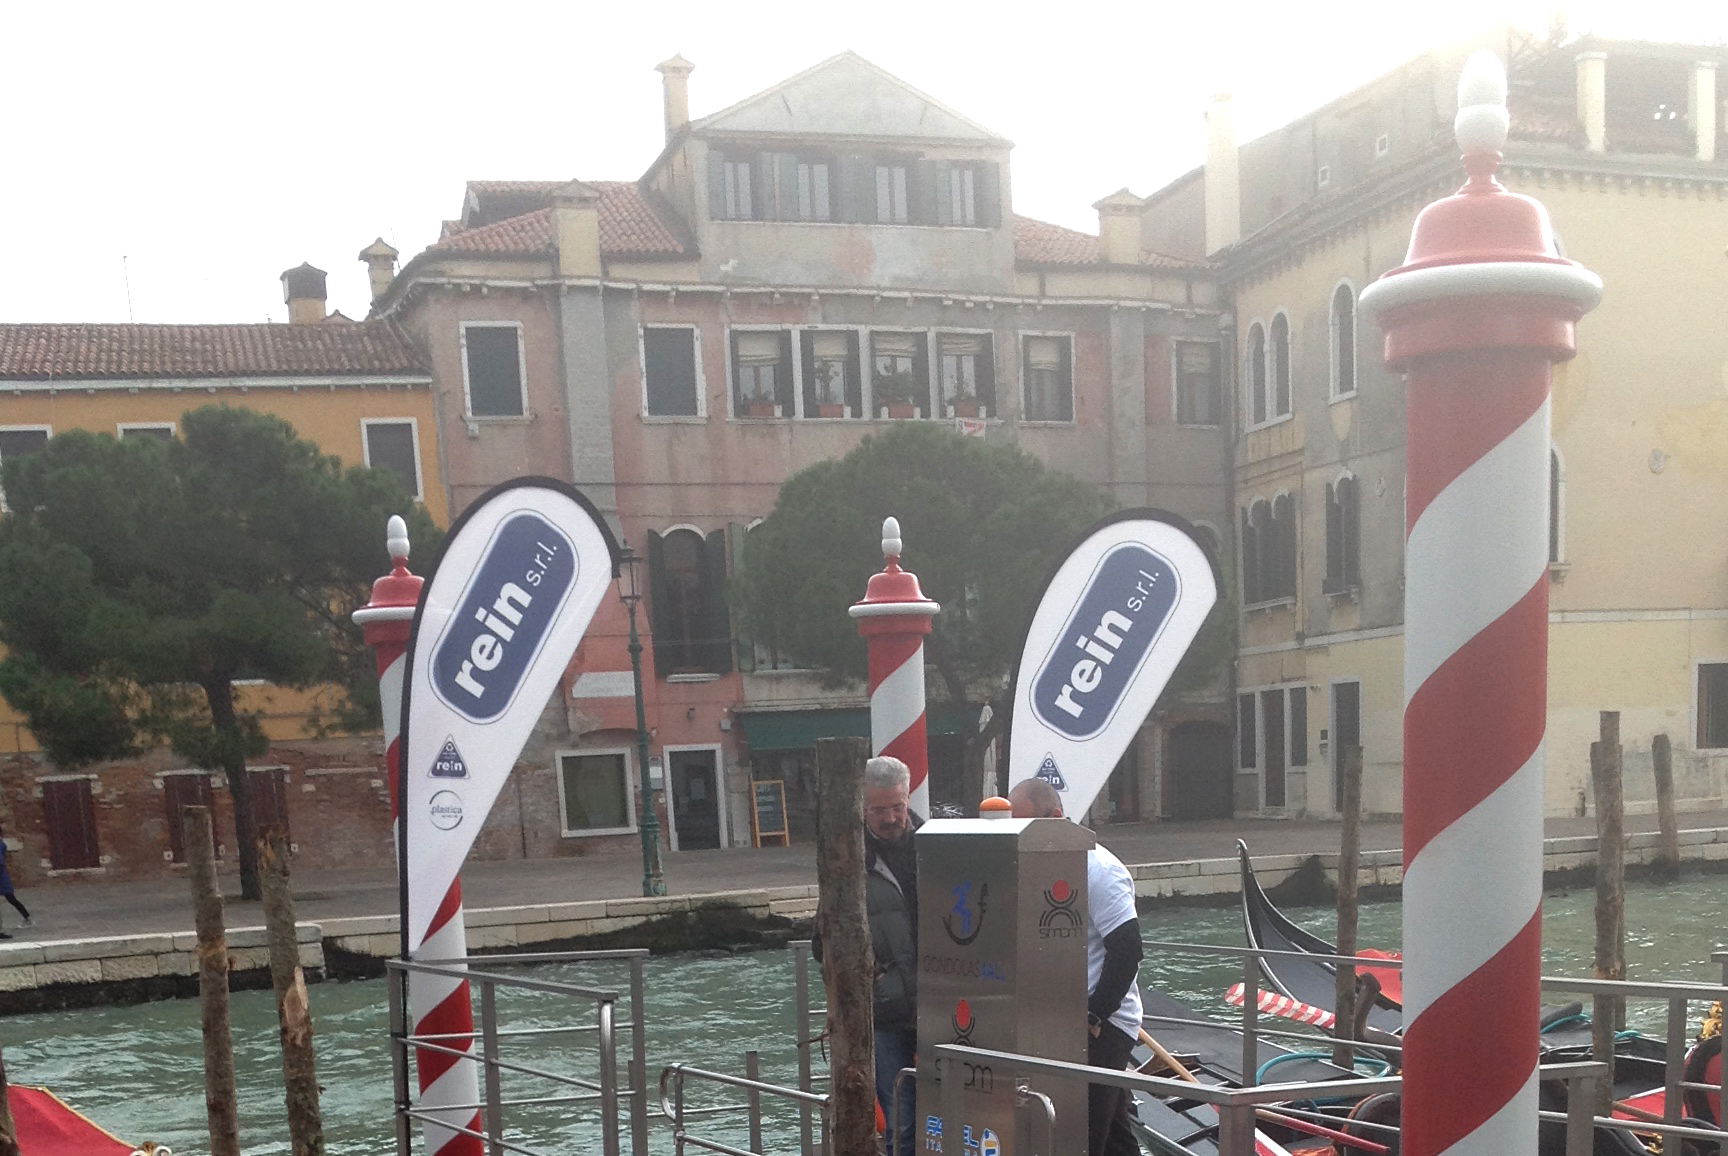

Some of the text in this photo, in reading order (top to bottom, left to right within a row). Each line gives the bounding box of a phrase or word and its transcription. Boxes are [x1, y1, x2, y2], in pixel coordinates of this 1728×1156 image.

[454, 541, 557, 699] rein s.r.l.
[1054, 569, 1160, 719] rein s.r.l.
[436, 760, 463, 771] rein
